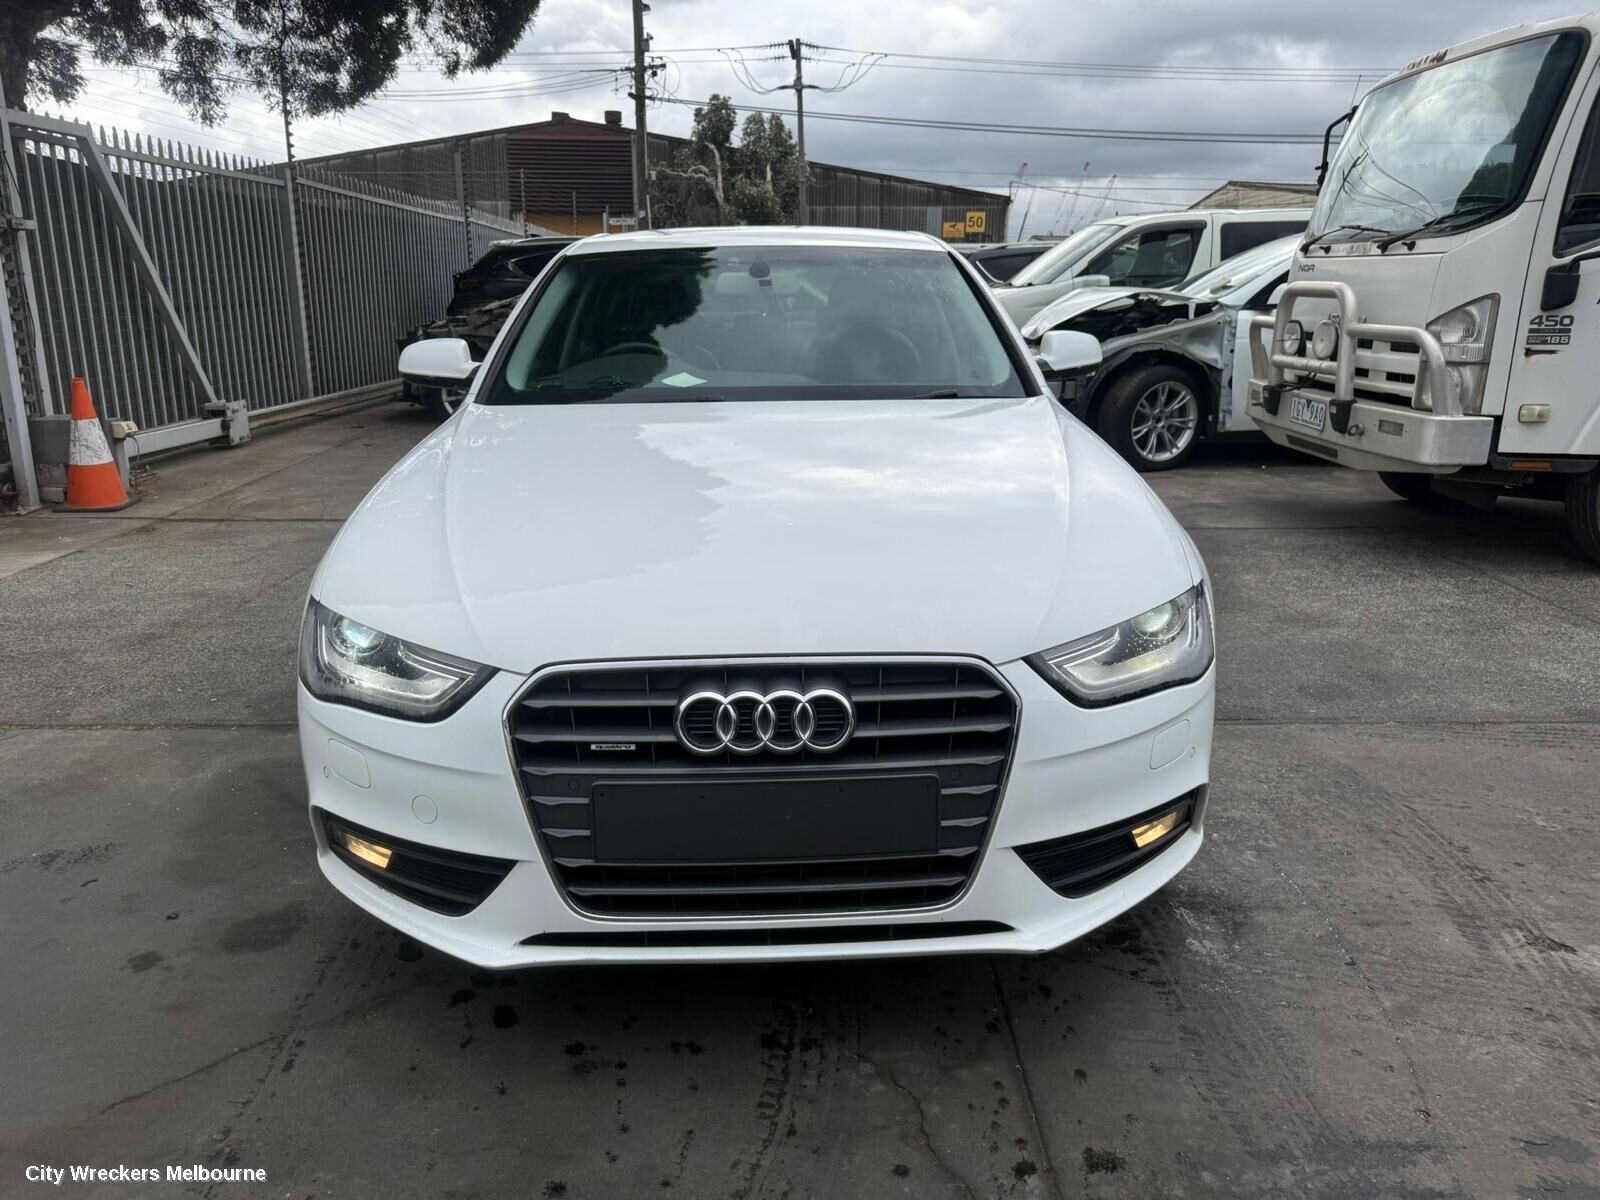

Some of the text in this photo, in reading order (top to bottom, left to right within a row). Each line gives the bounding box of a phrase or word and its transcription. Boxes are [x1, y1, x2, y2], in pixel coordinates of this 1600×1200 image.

[968, 216, 984, 228] 50
[1529, 315, 1574, 327] 450
[1546, 336, 1569, 344] 185
